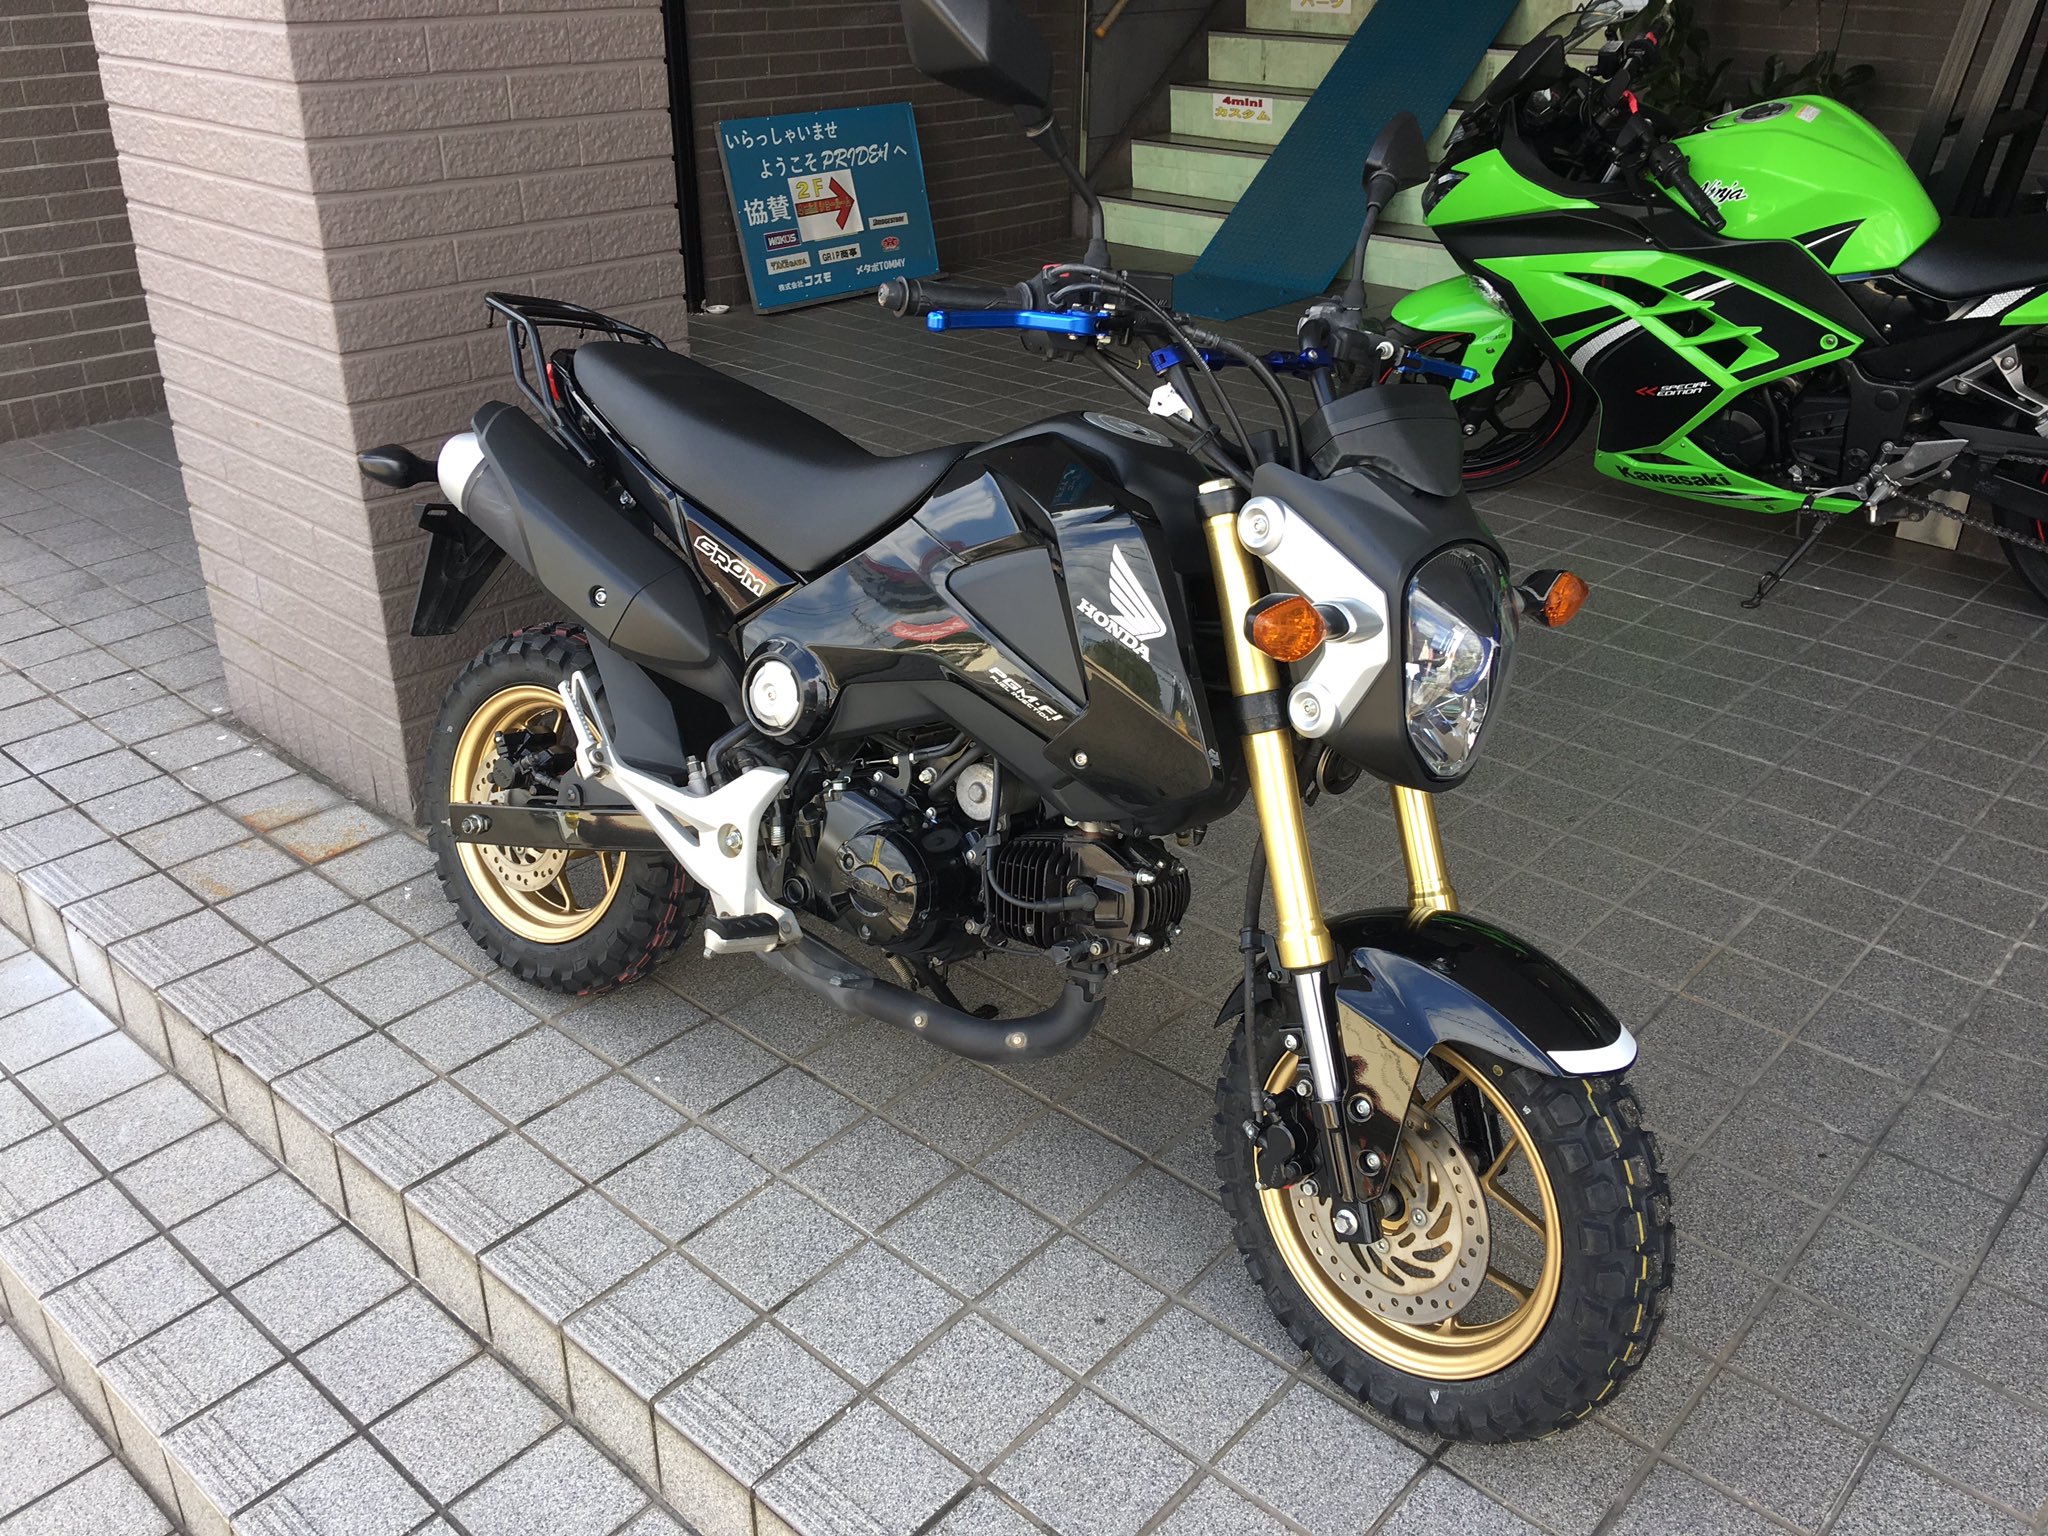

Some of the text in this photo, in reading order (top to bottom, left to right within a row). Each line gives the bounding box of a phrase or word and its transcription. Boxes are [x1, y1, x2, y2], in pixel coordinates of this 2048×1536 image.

[1215, 106, 1271, 121] カスタム
[1222, 96, 1263, 108] 4mini
[725, 121, 838, 150] いらっしゃいませ
[743, 194, 792, 227] 協賛
[1656, 387, 1703, 397] EDITION
[1661, 381, 1712, 390] SPECIAL
[1615, 464, 1733, 487] Kawasaki
[693, 535, 767, 598] GROM
[1076, 597, 1151, 663] HONDA
[989, 675, 1053, 722] FUEL INJECTION
